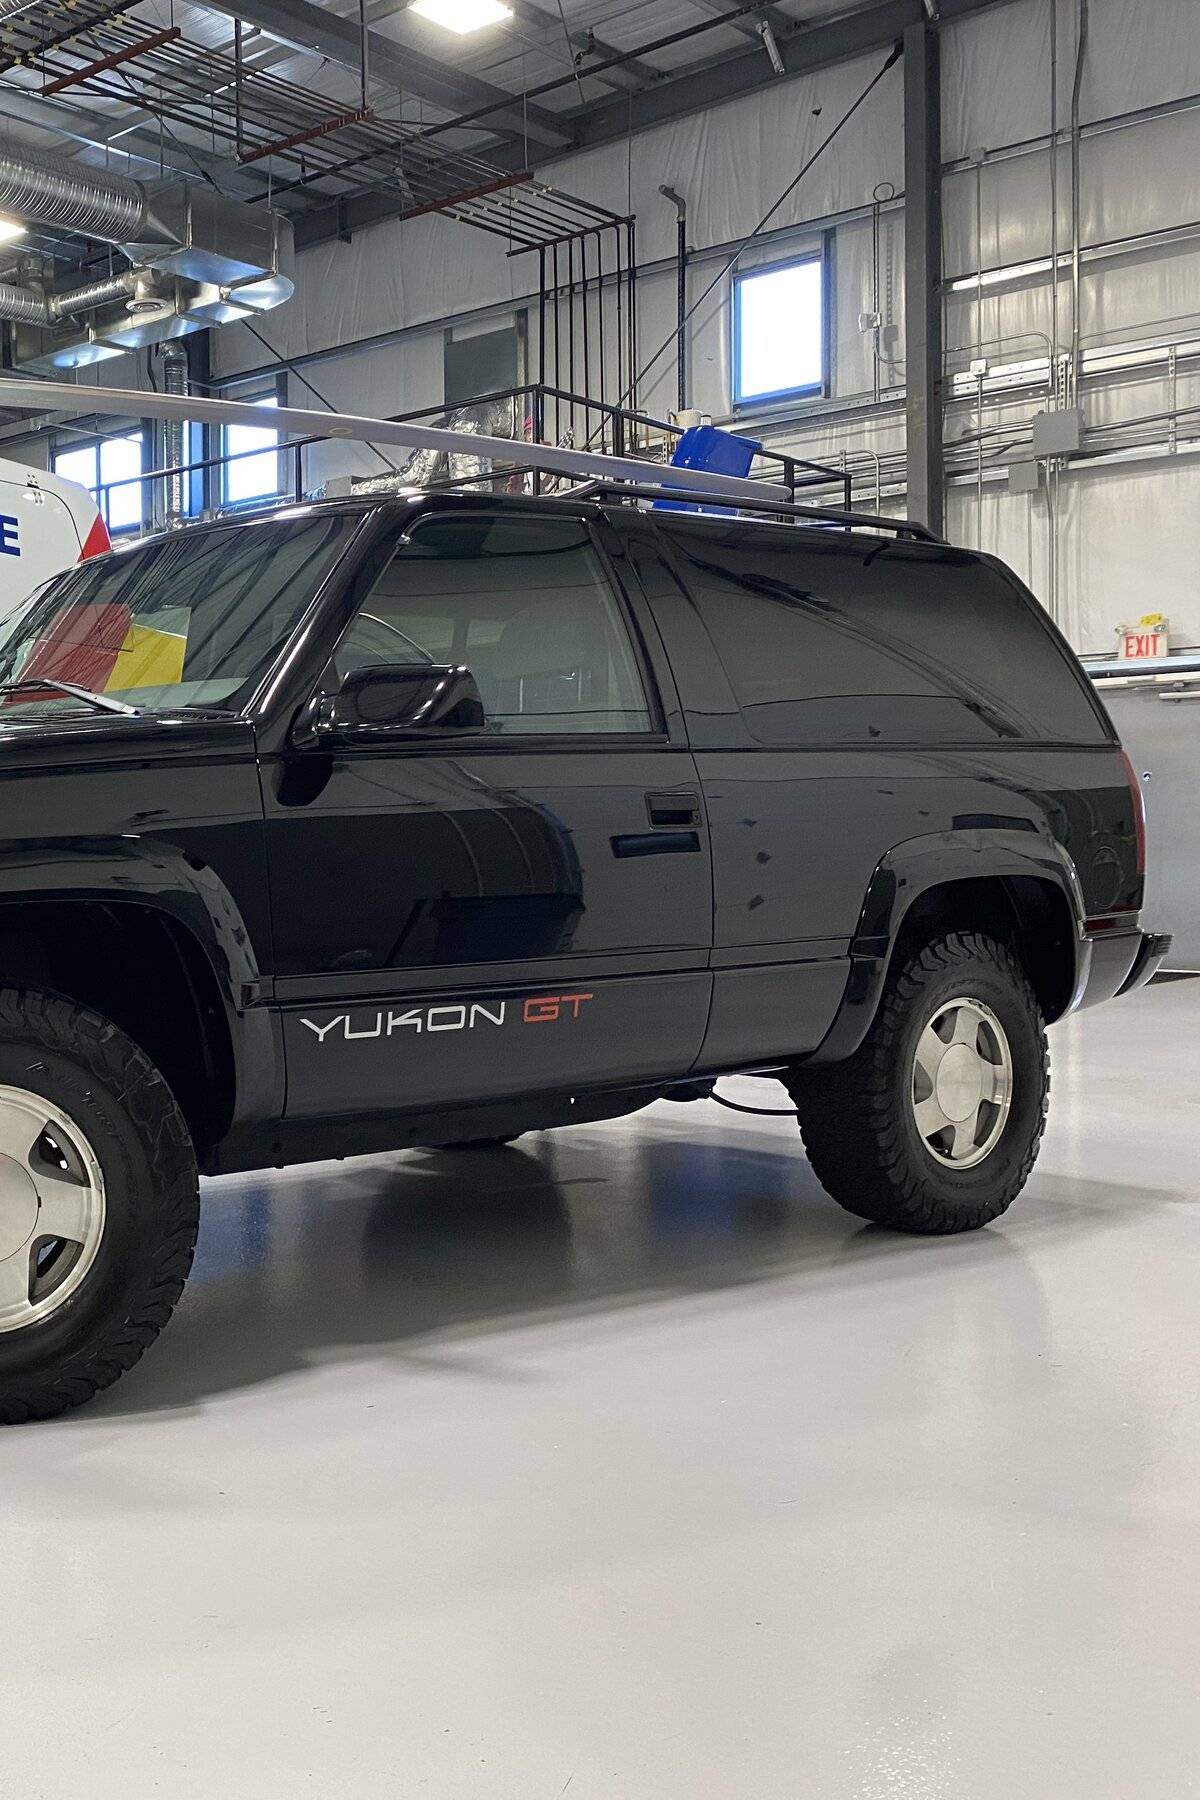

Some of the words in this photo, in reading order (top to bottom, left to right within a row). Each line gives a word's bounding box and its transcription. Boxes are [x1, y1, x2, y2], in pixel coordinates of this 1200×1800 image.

[1124, 633, 1161, 658] EXIT
[300, 1002, 505, 1042] YUKON
[523, 993, 593, 1022] GT
